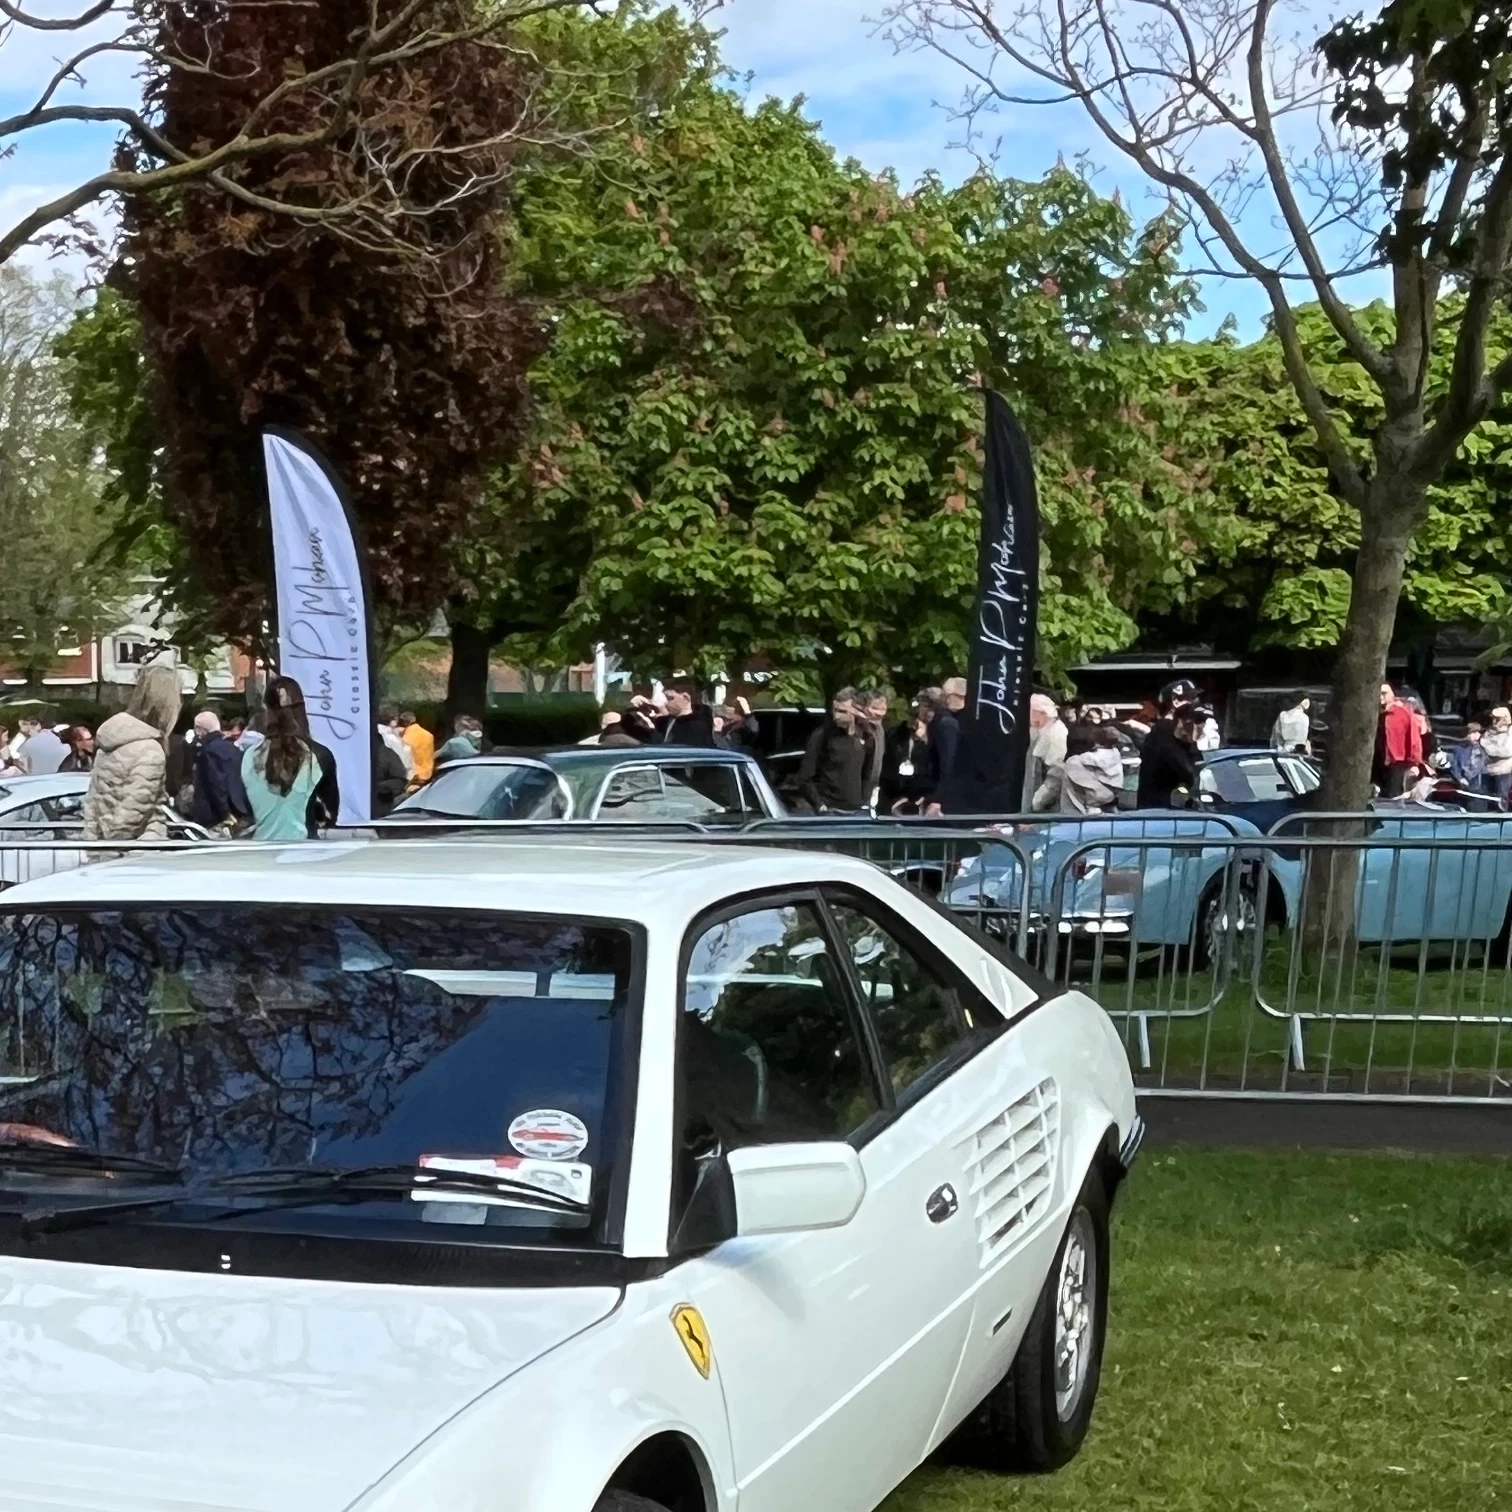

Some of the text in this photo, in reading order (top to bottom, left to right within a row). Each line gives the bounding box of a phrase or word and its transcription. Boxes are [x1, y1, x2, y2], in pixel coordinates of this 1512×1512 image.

[285, 620, 347, 661] P
[979, 600, 1016, 650] P
[305, 670, 357, 740] John
[975, 656, 1016, 735] John
